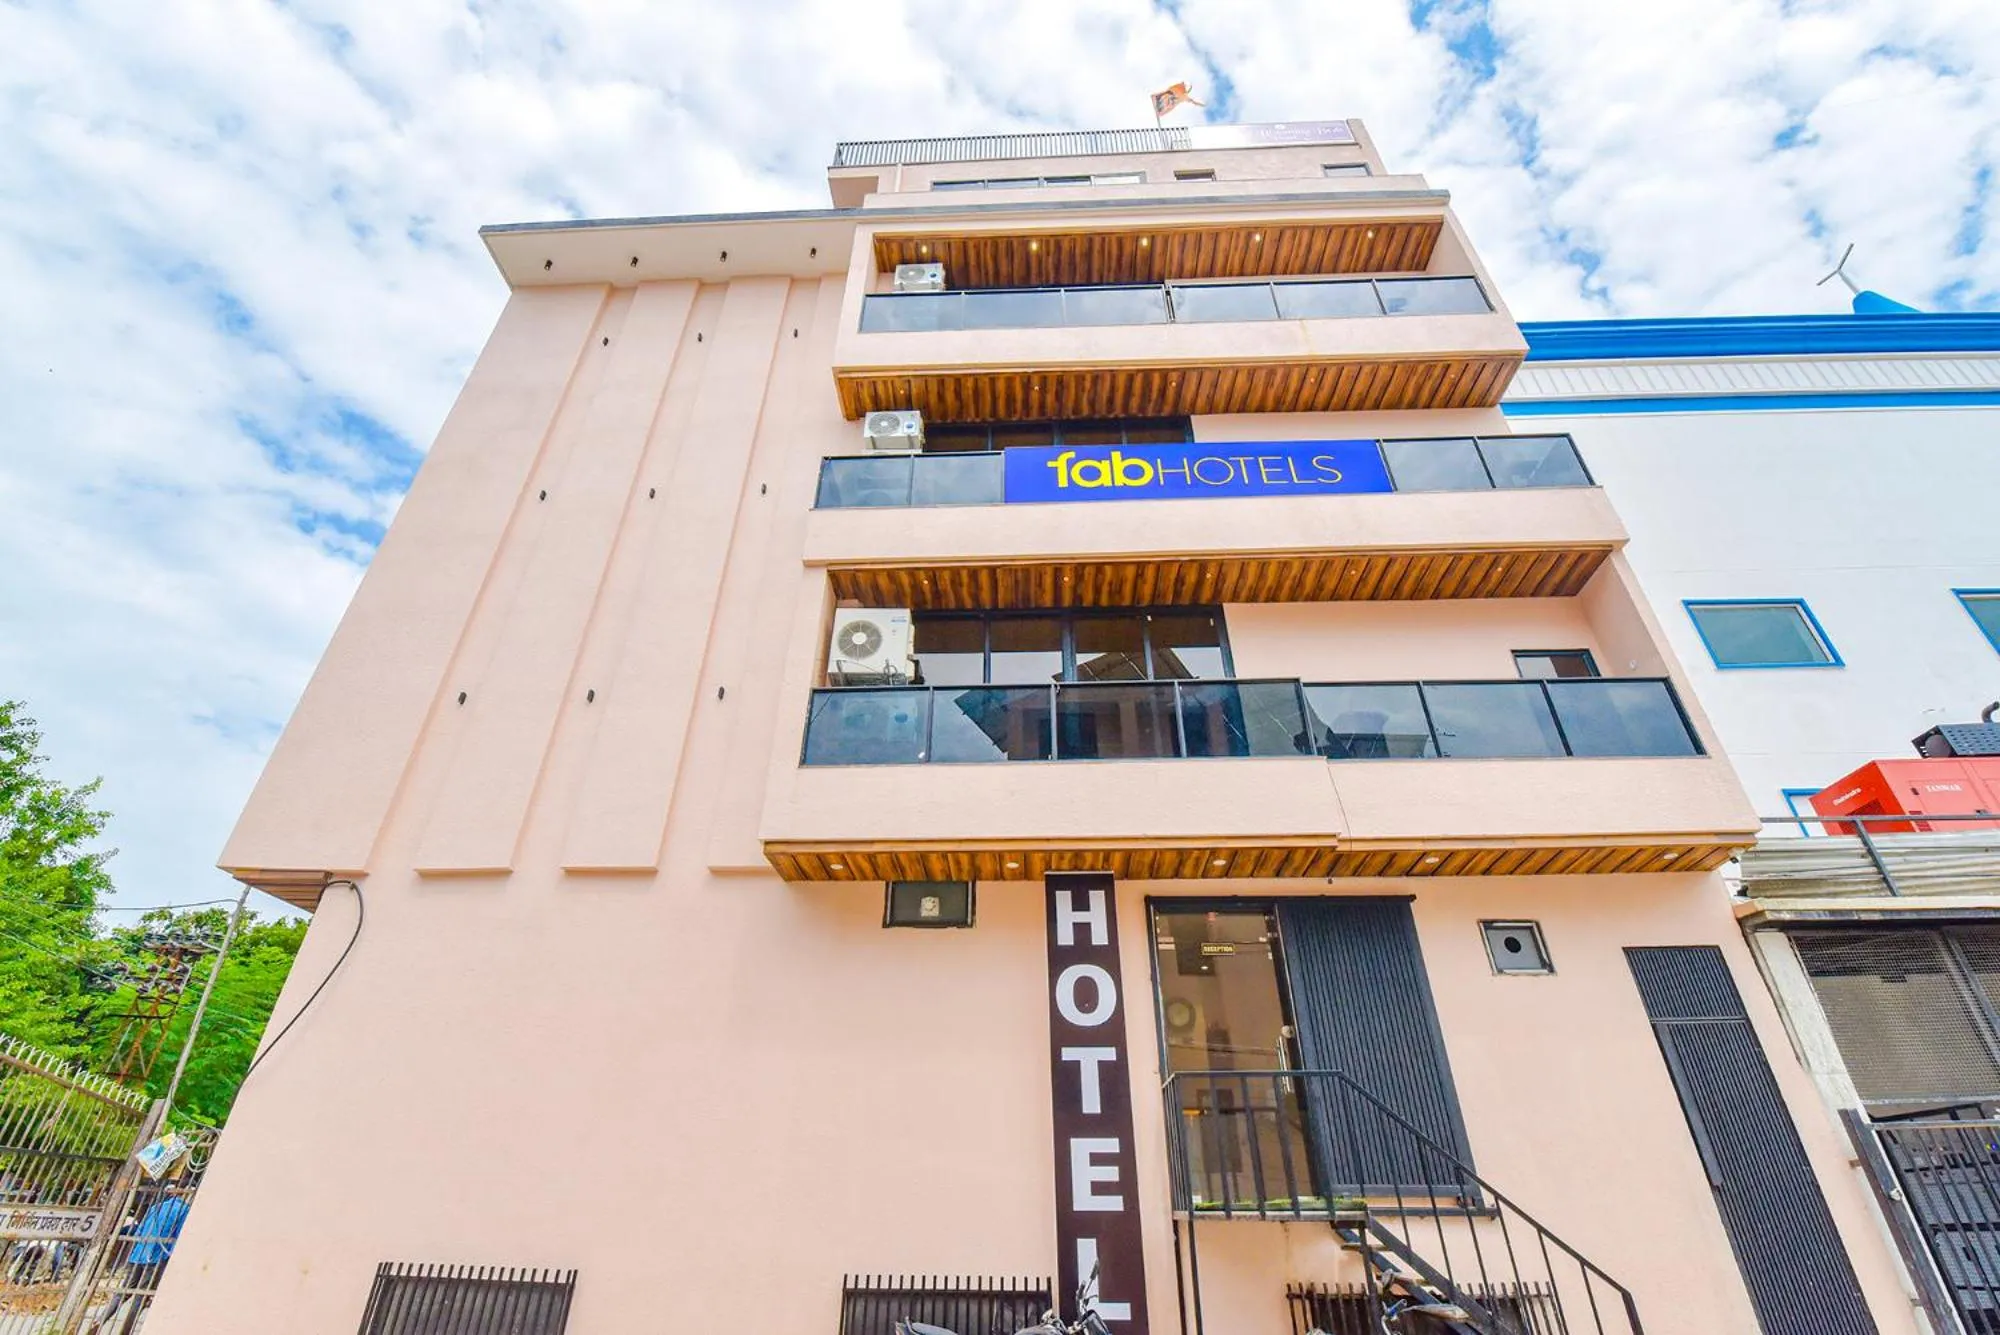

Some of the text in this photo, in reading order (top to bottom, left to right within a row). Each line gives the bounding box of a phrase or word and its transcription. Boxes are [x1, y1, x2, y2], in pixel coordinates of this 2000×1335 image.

[1047, 451, 1343, 488] fabHOTELS
[1055, 890, 1131, 1321] HOTEL
[80, 1215, 96, 1232] 5
